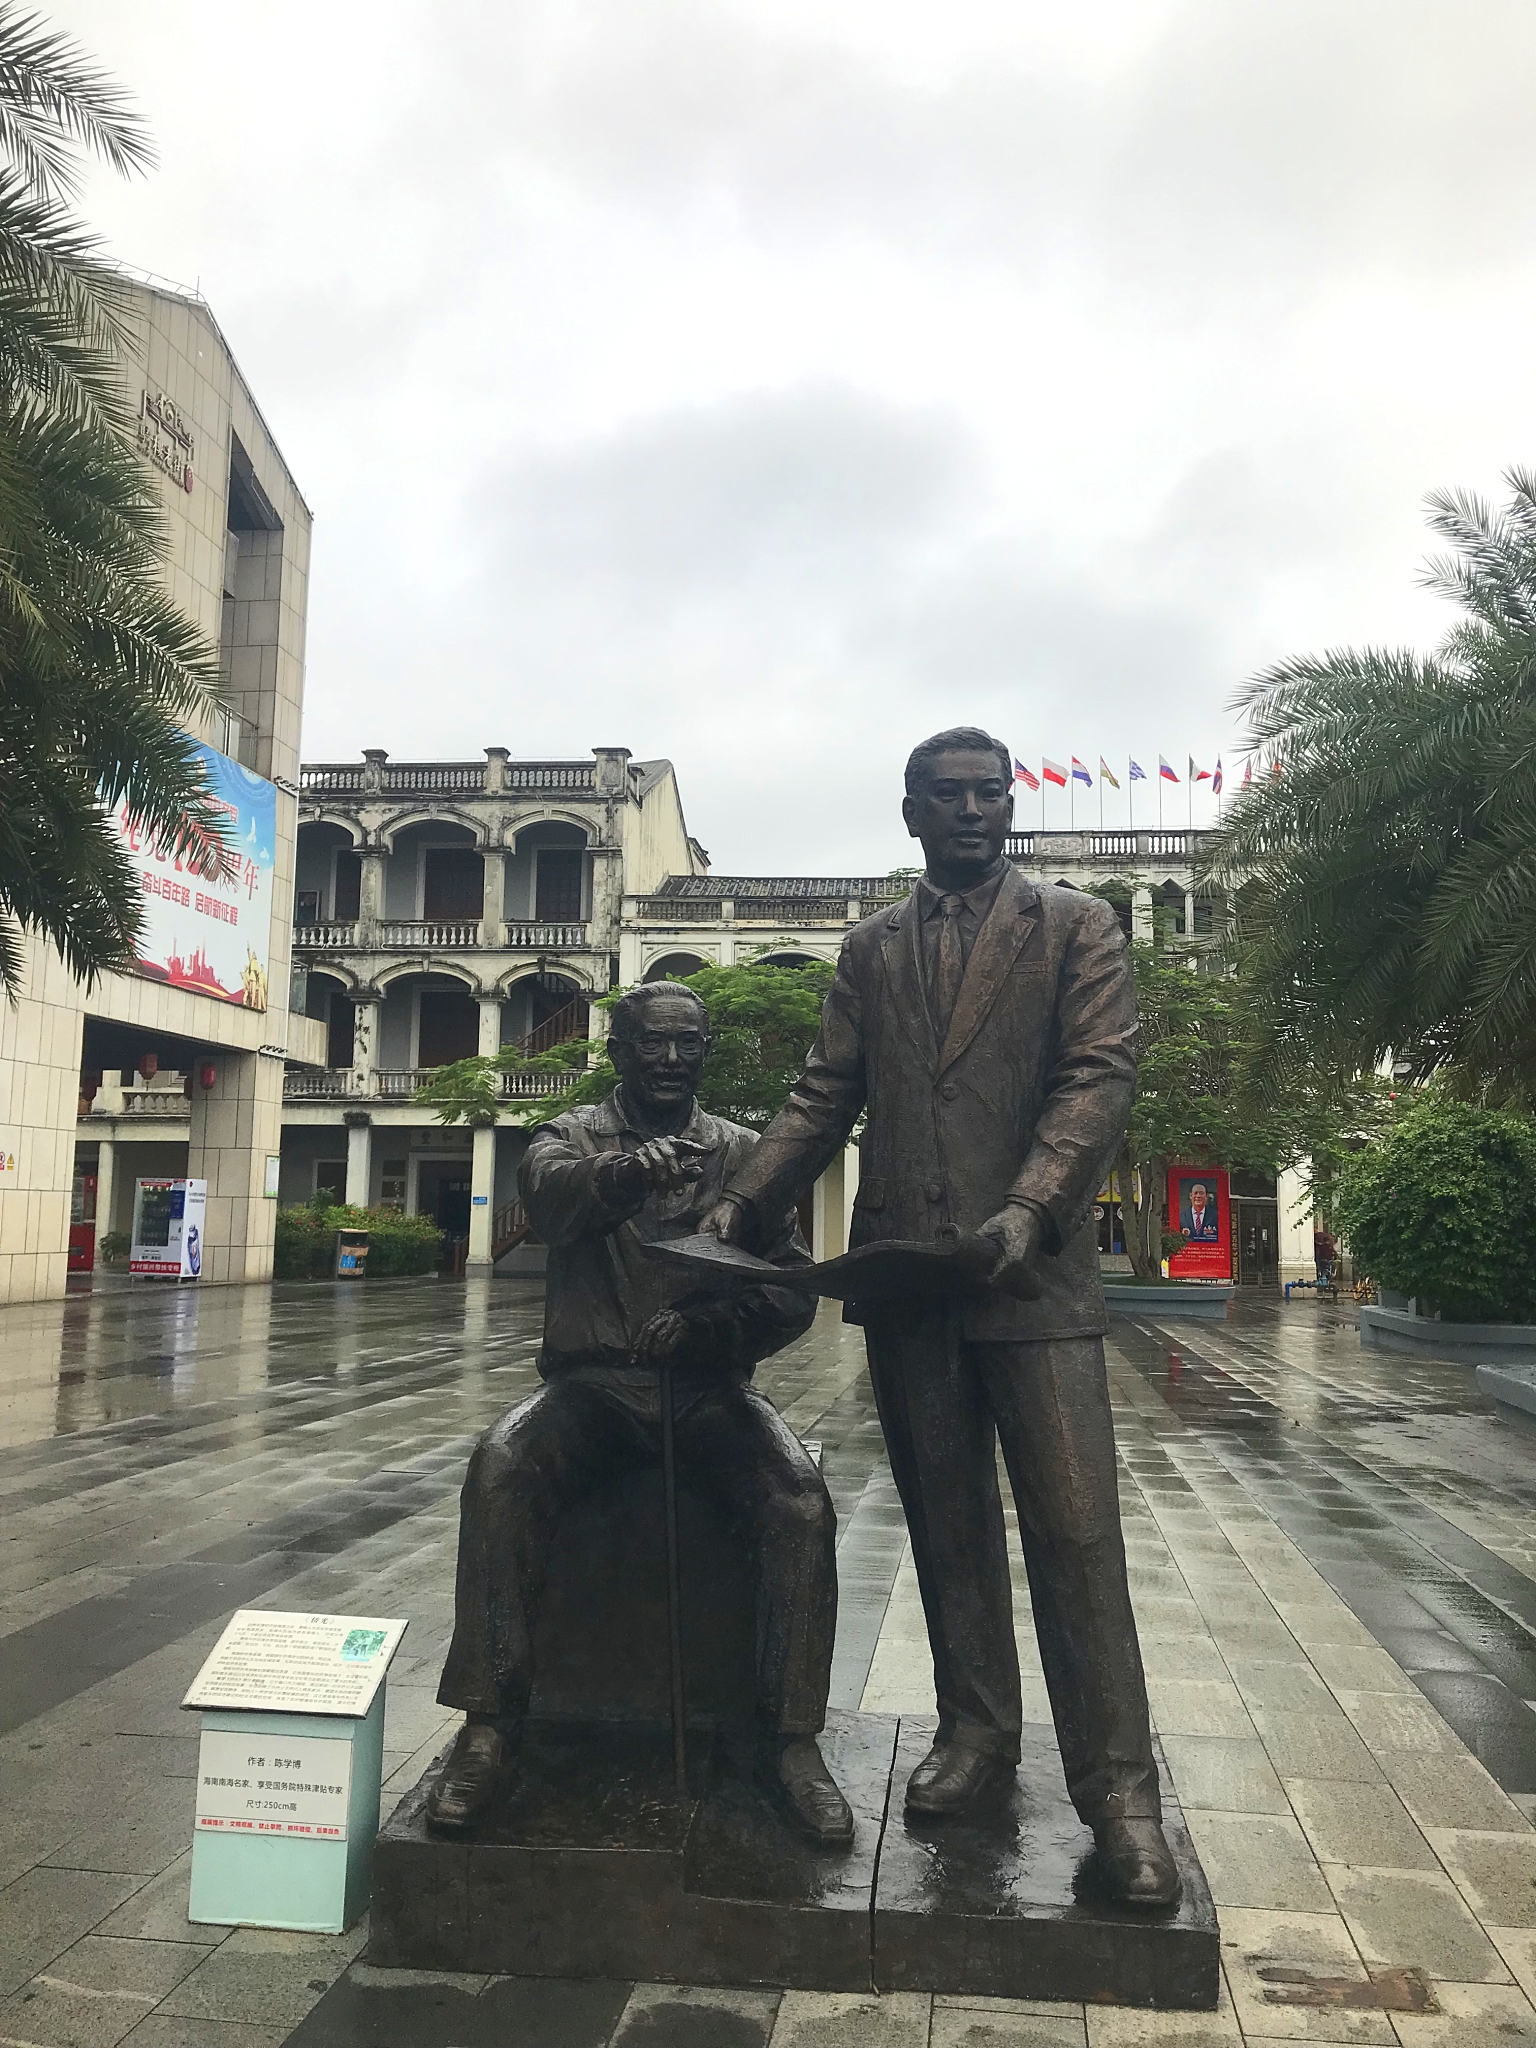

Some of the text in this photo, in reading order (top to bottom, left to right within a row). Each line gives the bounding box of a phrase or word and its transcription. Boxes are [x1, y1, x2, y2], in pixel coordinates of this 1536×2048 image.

[141, 871, 239, 926] 奋斗百年路 启航新征程
[247, 1756, 302, 1770] 作者：陈学博
